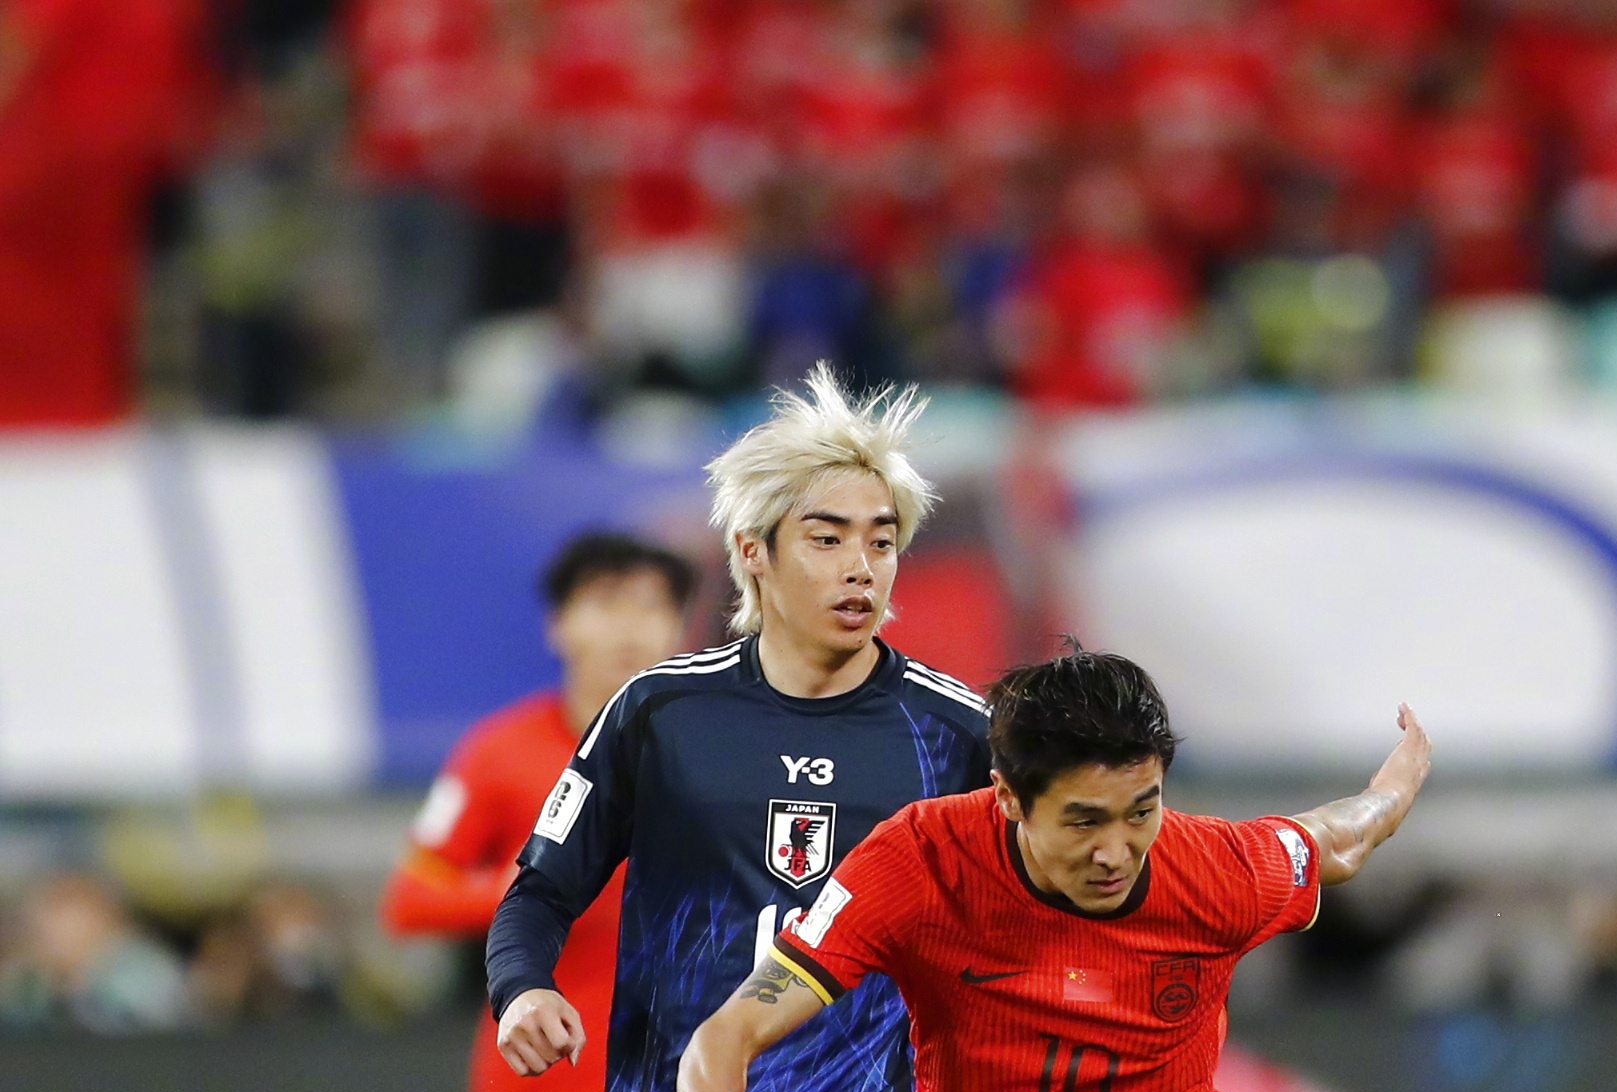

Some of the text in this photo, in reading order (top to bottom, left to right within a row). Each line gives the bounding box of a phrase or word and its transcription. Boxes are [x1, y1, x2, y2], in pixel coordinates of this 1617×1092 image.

[780, 755, 834, 785] Y-3
[785, 804, 820, 813] JAPAN
[784, 859, 811, 872] JFA
